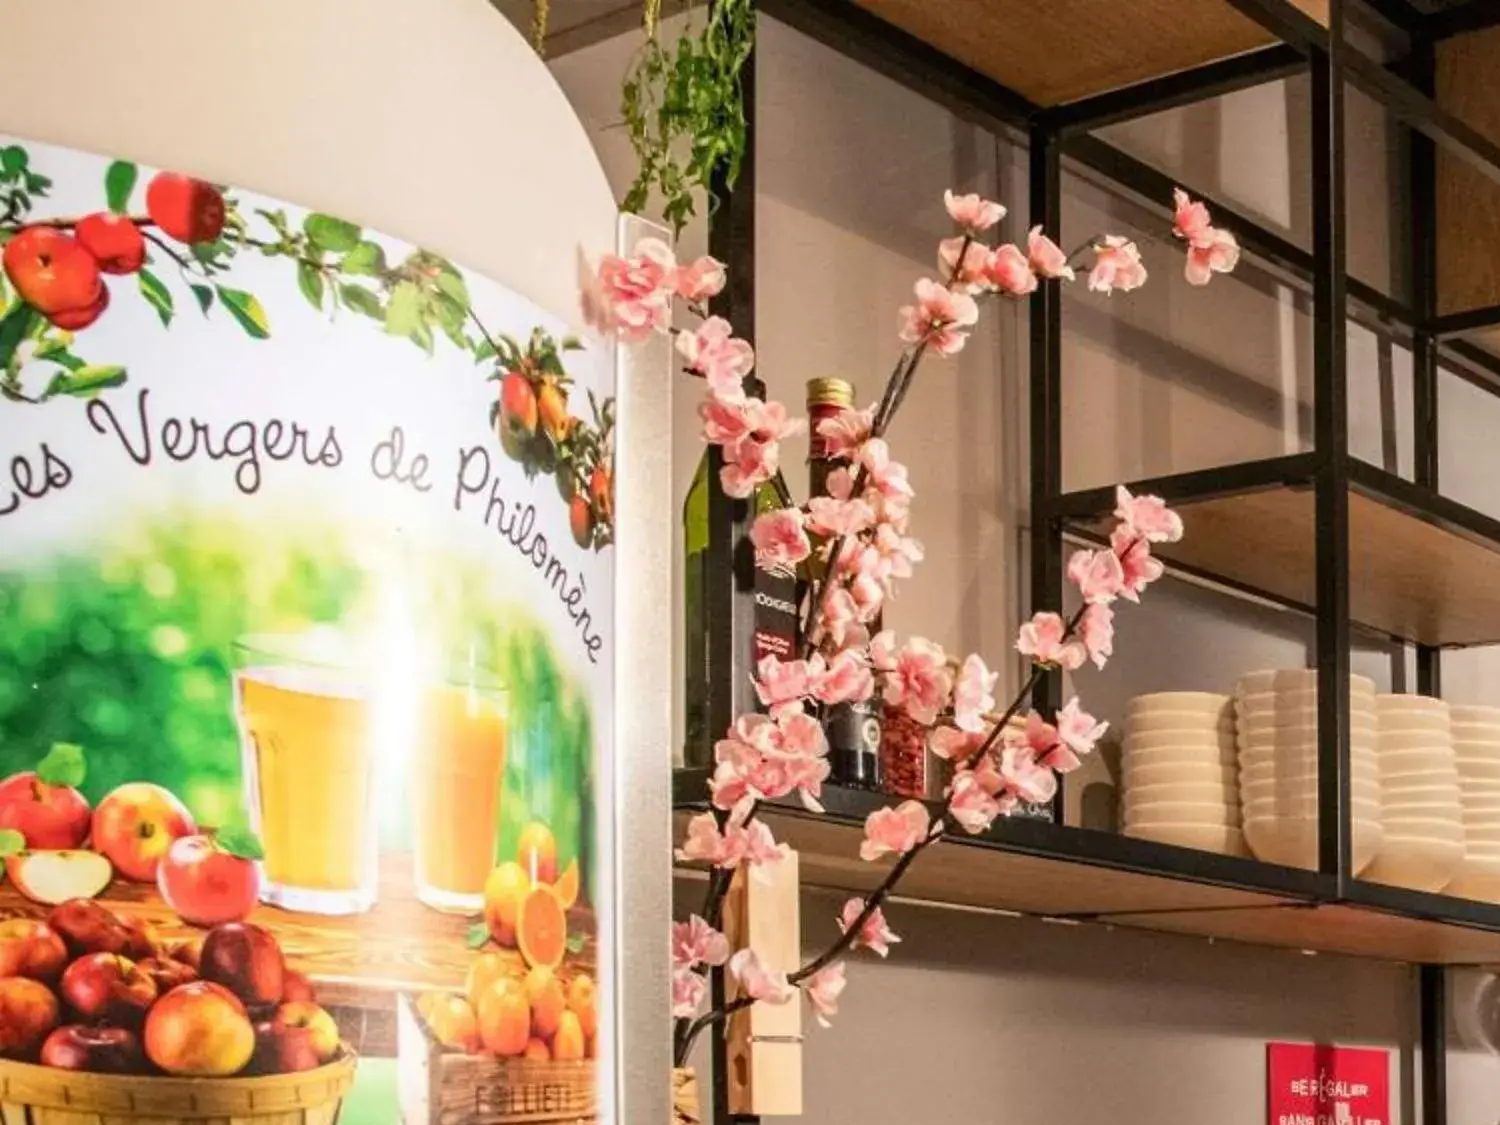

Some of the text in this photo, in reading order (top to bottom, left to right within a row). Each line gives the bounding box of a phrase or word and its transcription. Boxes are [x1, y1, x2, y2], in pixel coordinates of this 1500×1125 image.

[86, 388, 343, 494] Vergers
[371, 426, 433, 492] de
[454, 445, 603, 664] Philomène
